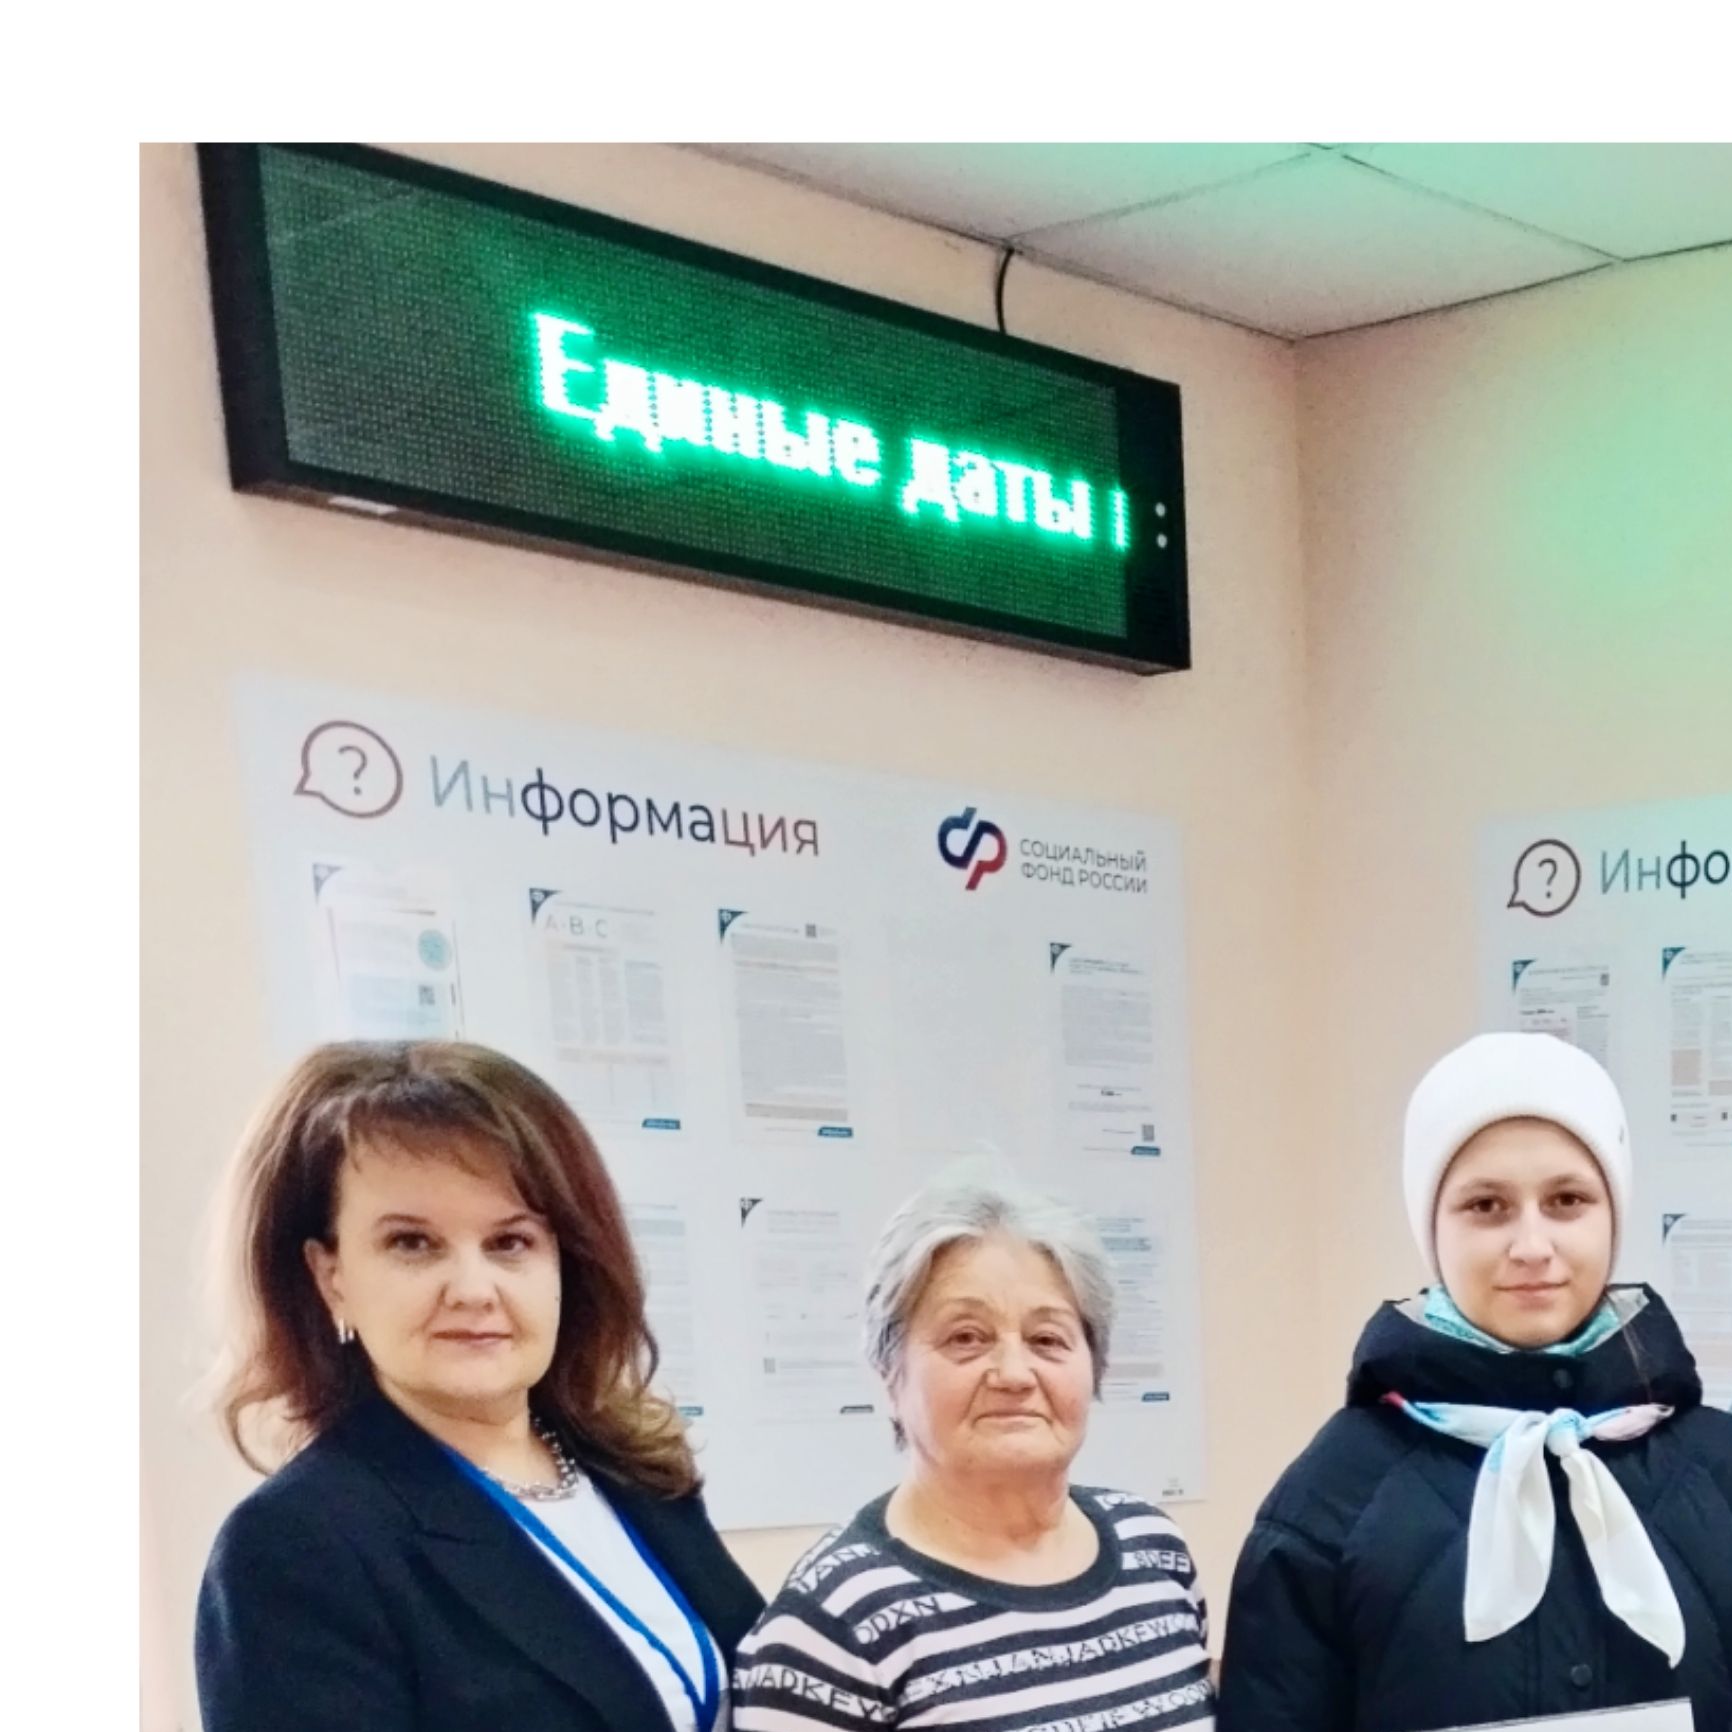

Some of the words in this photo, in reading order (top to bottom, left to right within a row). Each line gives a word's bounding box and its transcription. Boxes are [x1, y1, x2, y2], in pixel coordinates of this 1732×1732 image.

[530, 312, 882, 487] Единые
[900, 436, 1093, 540] даты
[430, 754, 821, 858] Информация
[1019, 838, 1147, 873] СОЦИАЛЬНЫЙ
[1021, 862, 1075, 887] ФОНД
[1079, 869, 1149, 894] РОССИИ
